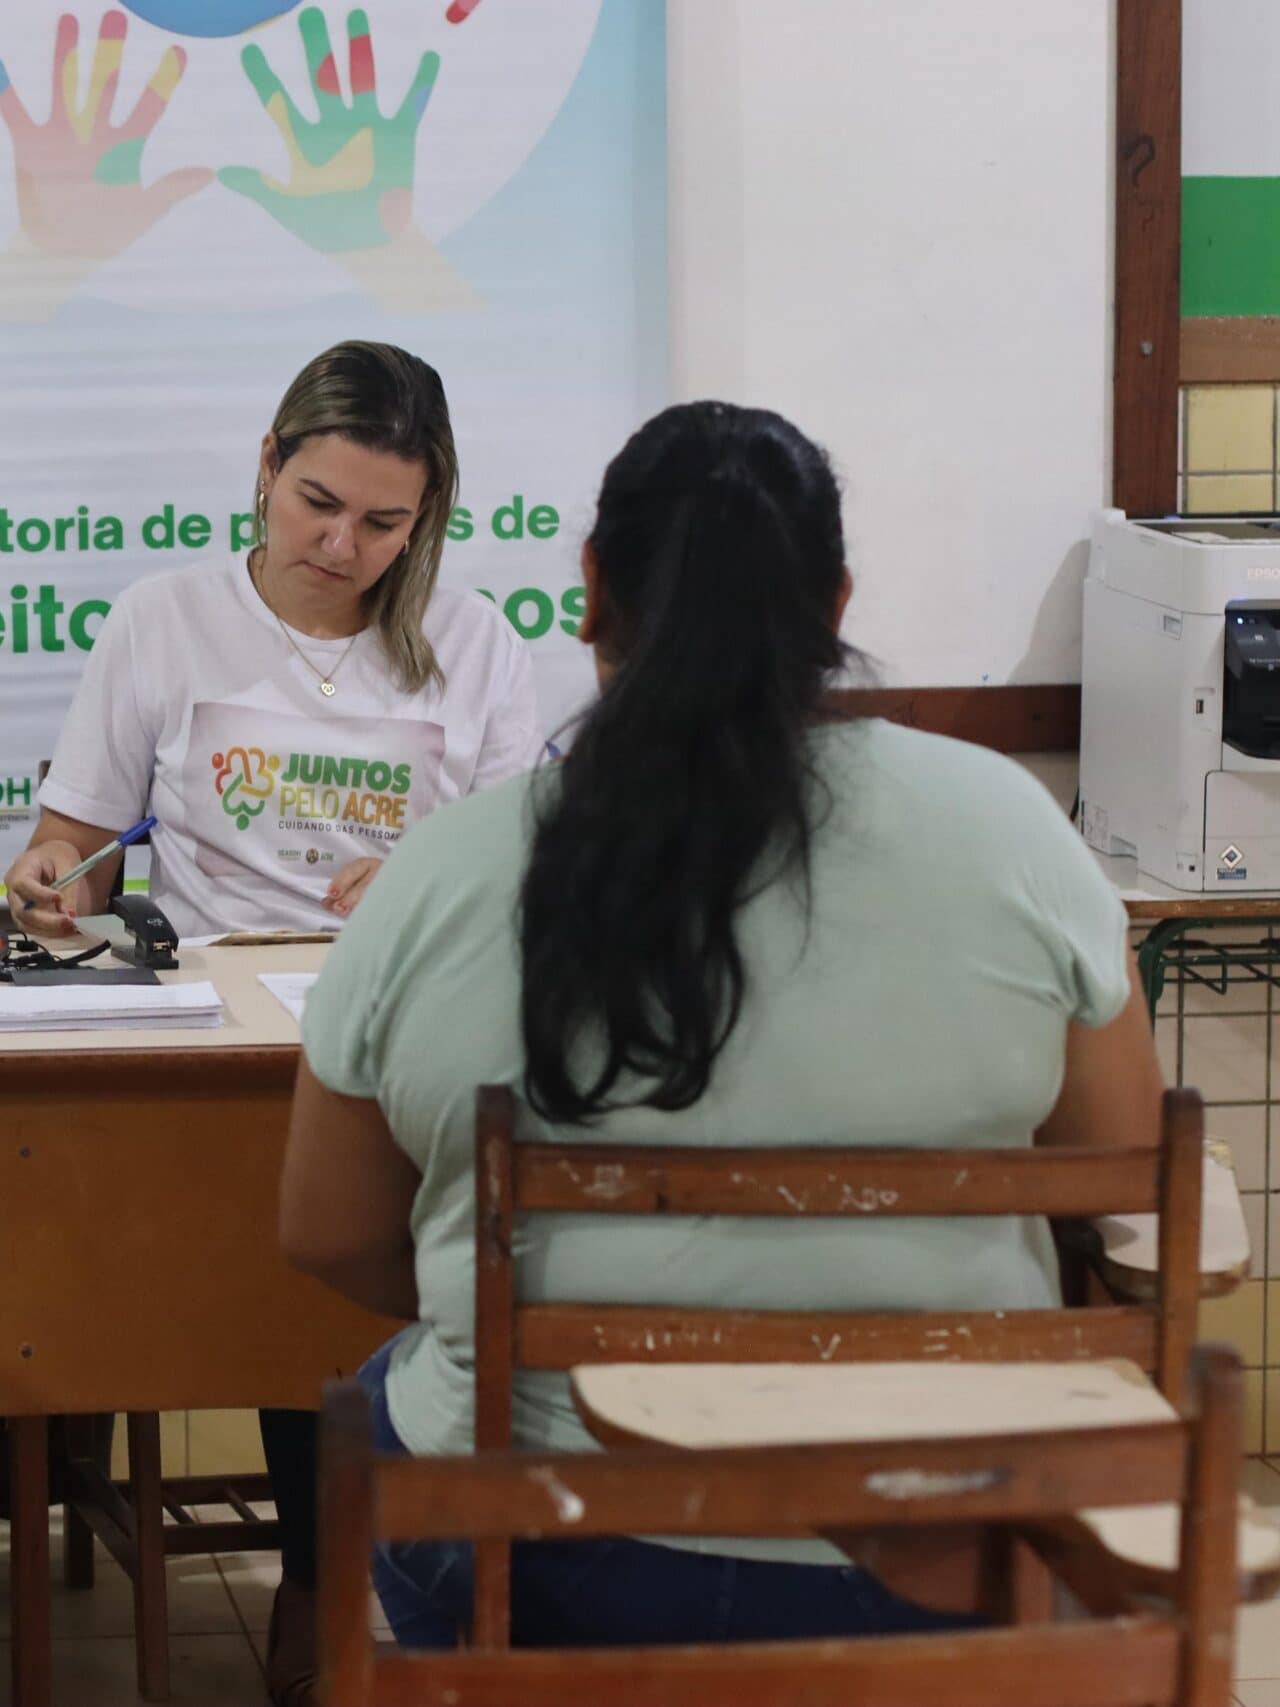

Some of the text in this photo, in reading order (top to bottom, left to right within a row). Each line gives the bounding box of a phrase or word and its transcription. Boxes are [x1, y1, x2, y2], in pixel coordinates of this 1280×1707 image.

[141, 503, 212, 549] de
[491, 495, 560, 540] de
[1247, 567, 1280, 579] EPSO
[280, 753, 412, 795] JUNTOS
[278, 820, 332, 833] CUIDANDO
[335, 824, 354, 836] DAS
[279, 785, 408, 829] PELO ACRE
